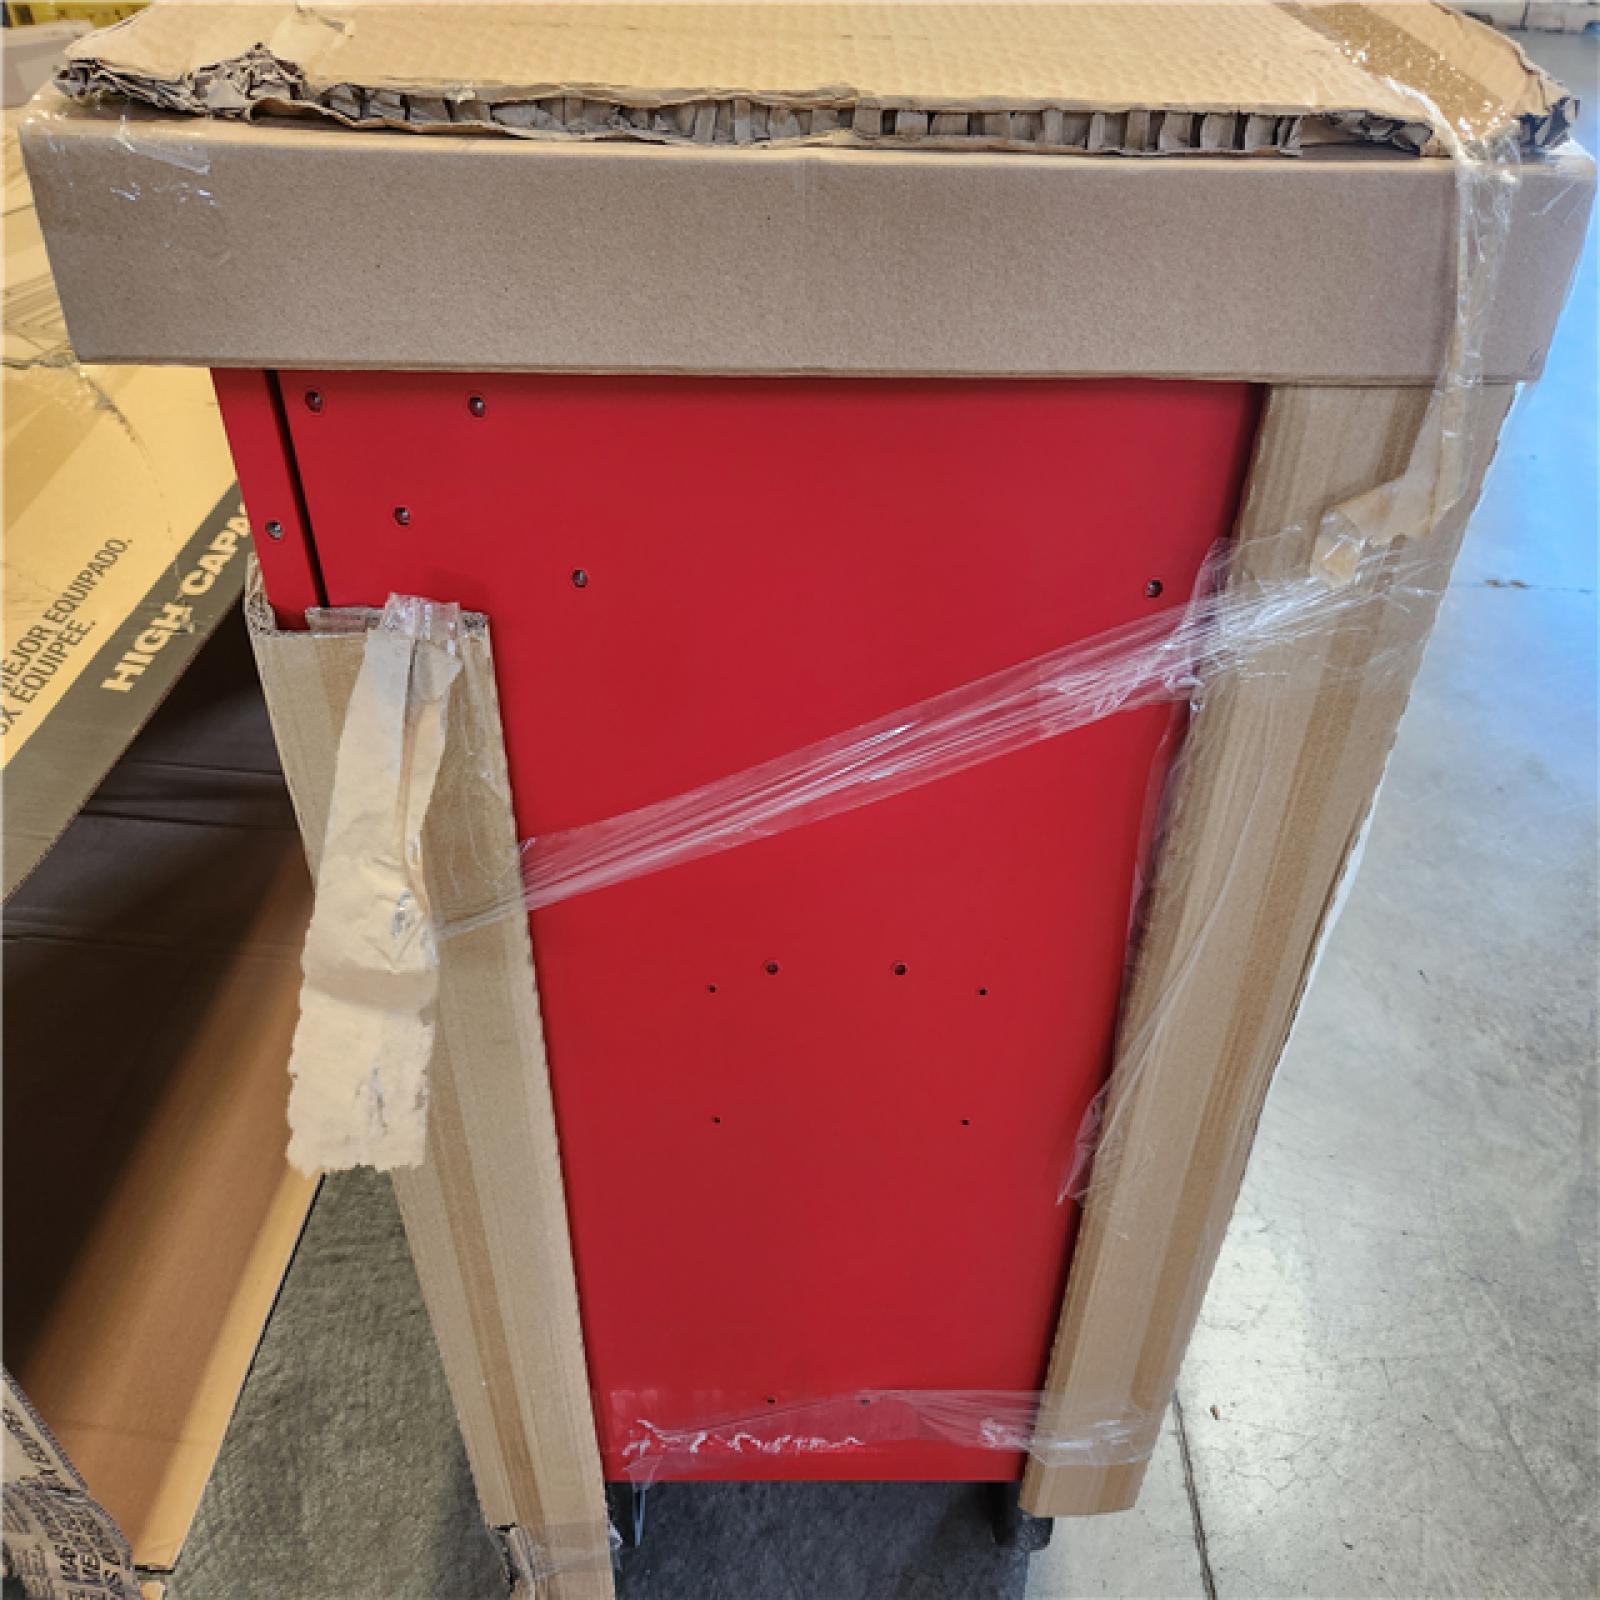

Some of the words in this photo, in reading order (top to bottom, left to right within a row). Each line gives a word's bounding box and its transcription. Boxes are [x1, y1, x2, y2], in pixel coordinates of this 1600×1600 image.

[42, 538, 134, 624] EQUIPADO.
[100, 602, 194, 692] HIGH
[179, 502, 251, 596] CAPA
